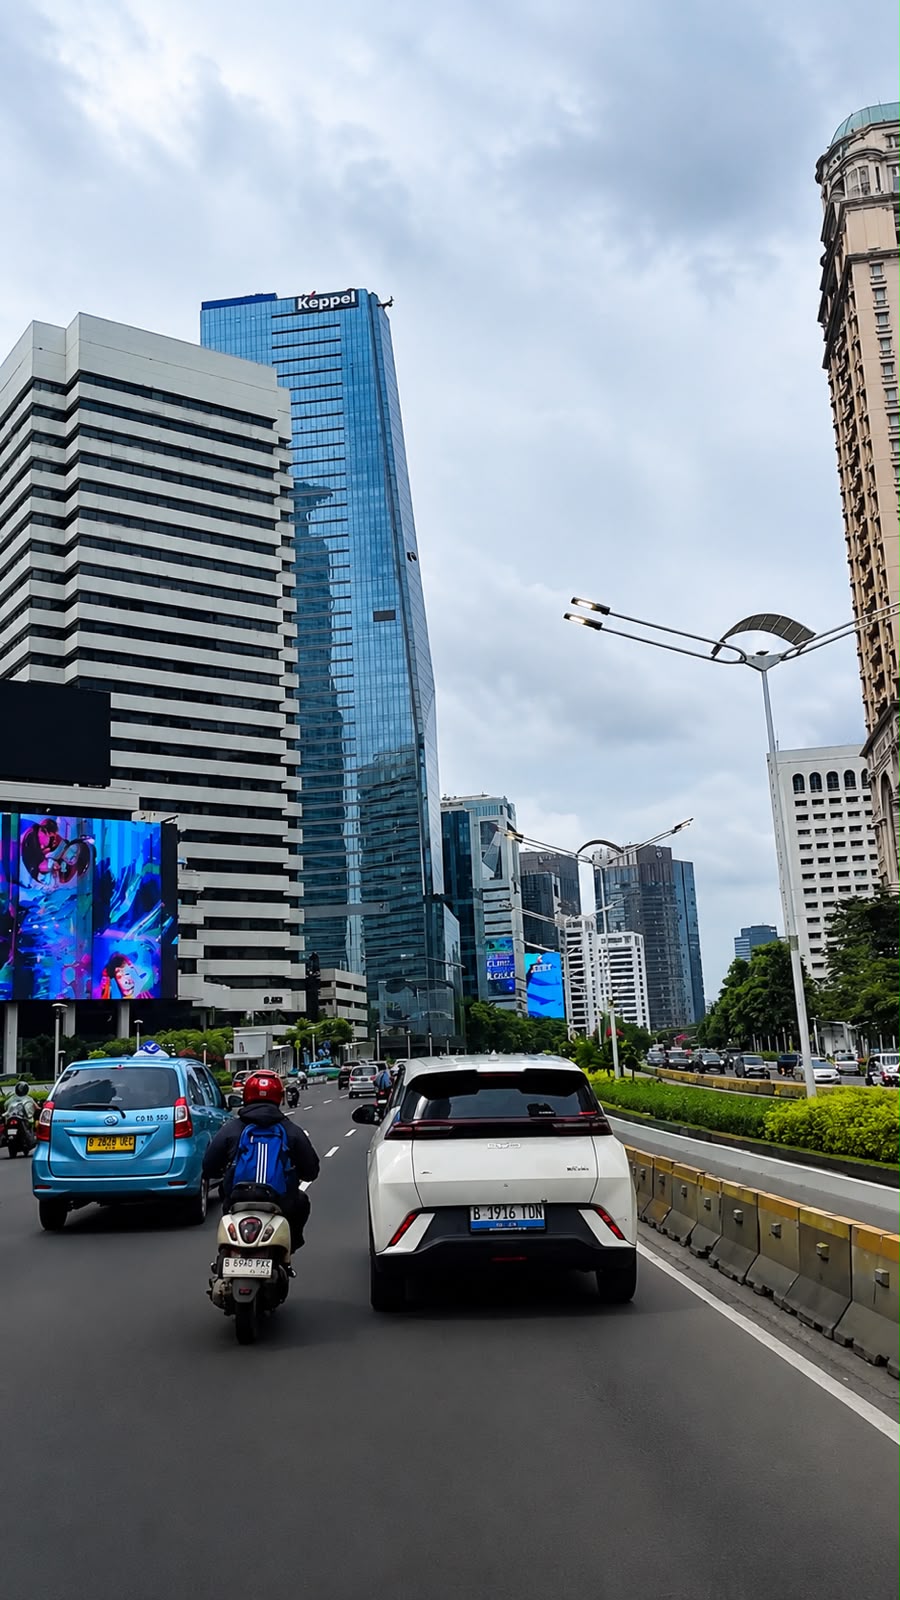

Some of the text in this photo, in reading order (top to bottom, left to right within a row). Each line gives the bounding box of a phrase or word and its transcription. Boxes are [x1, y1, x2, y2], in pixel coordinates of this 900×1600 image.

[297, 290, 356, 310] Keppel
[473, 1203, 543, 1220] B 1916 TDN
